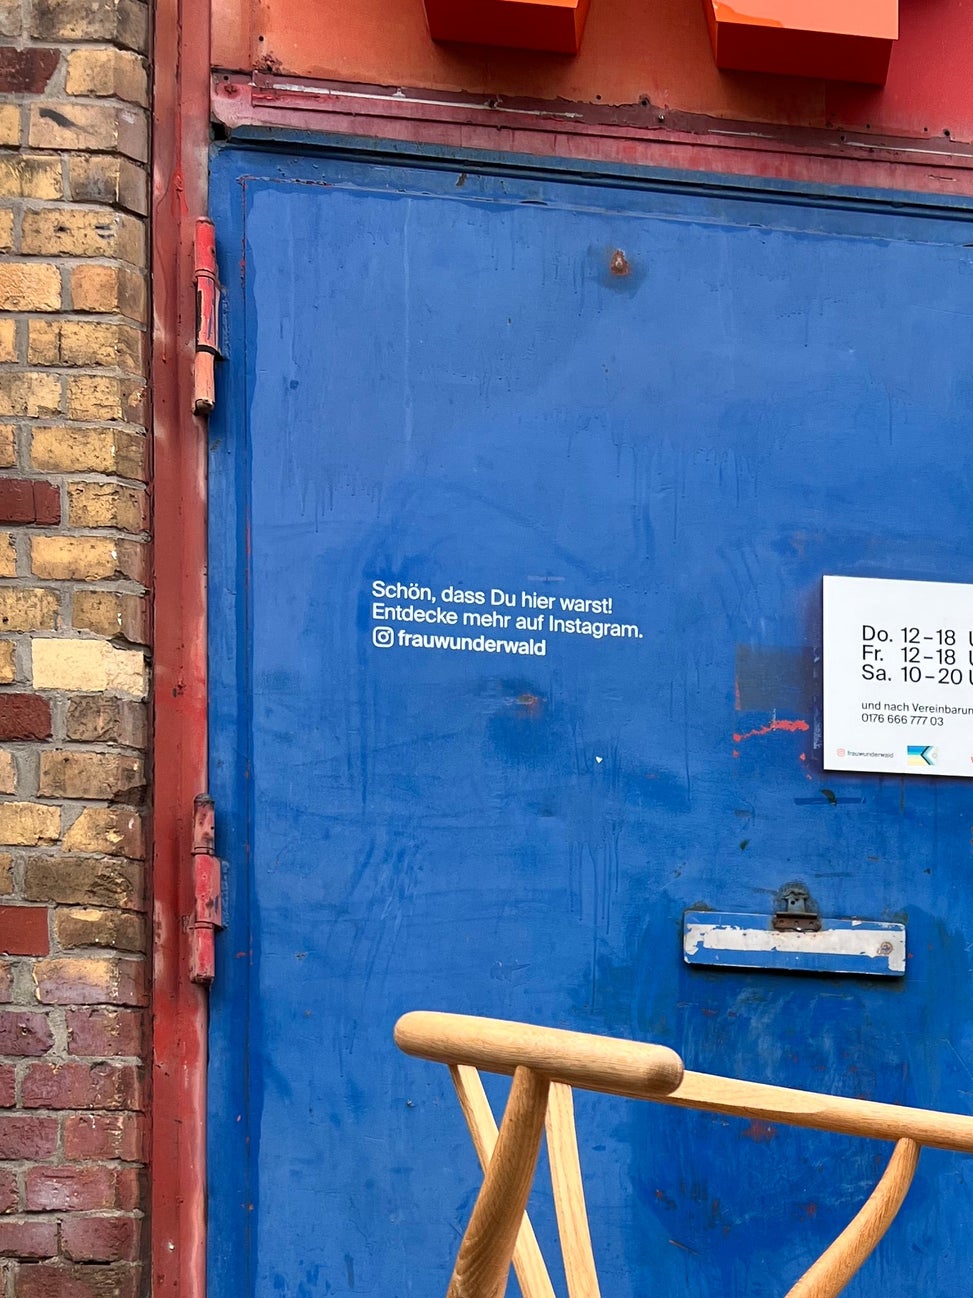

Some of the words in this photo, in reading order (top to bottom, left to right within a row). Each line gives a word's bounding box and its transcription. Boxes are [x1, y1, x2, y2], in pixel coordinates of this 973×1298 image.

[372, 580, 437, 604] Schön,
[441, 586, 486, 605] dass
[490, 589, 516, 607] Du
[521, 592, 556, 610] hier
[559, 597, 613, 614] warst!
[372, 602, 458, 625] Entdecke
[463, 610, 511, 629] mehr
[516, 615, 545, 631] auf
[549, 615, 643, 639] Instagram.
[862, 625, 893, 642] Do.
[397, 630, 546, 656] frauwunderwald
[862, 644, 884, 661] Fr.
[861, 664, 892, 681] Sa.
[861, 701, 881, 710] und
[884, 702, 909, 712] nach
[861, 713, 885, 723] 0176
[887, 714, 908, 724] 666
[910, 715, 928, 725] 777
[929, 716, 944, 726] 03
